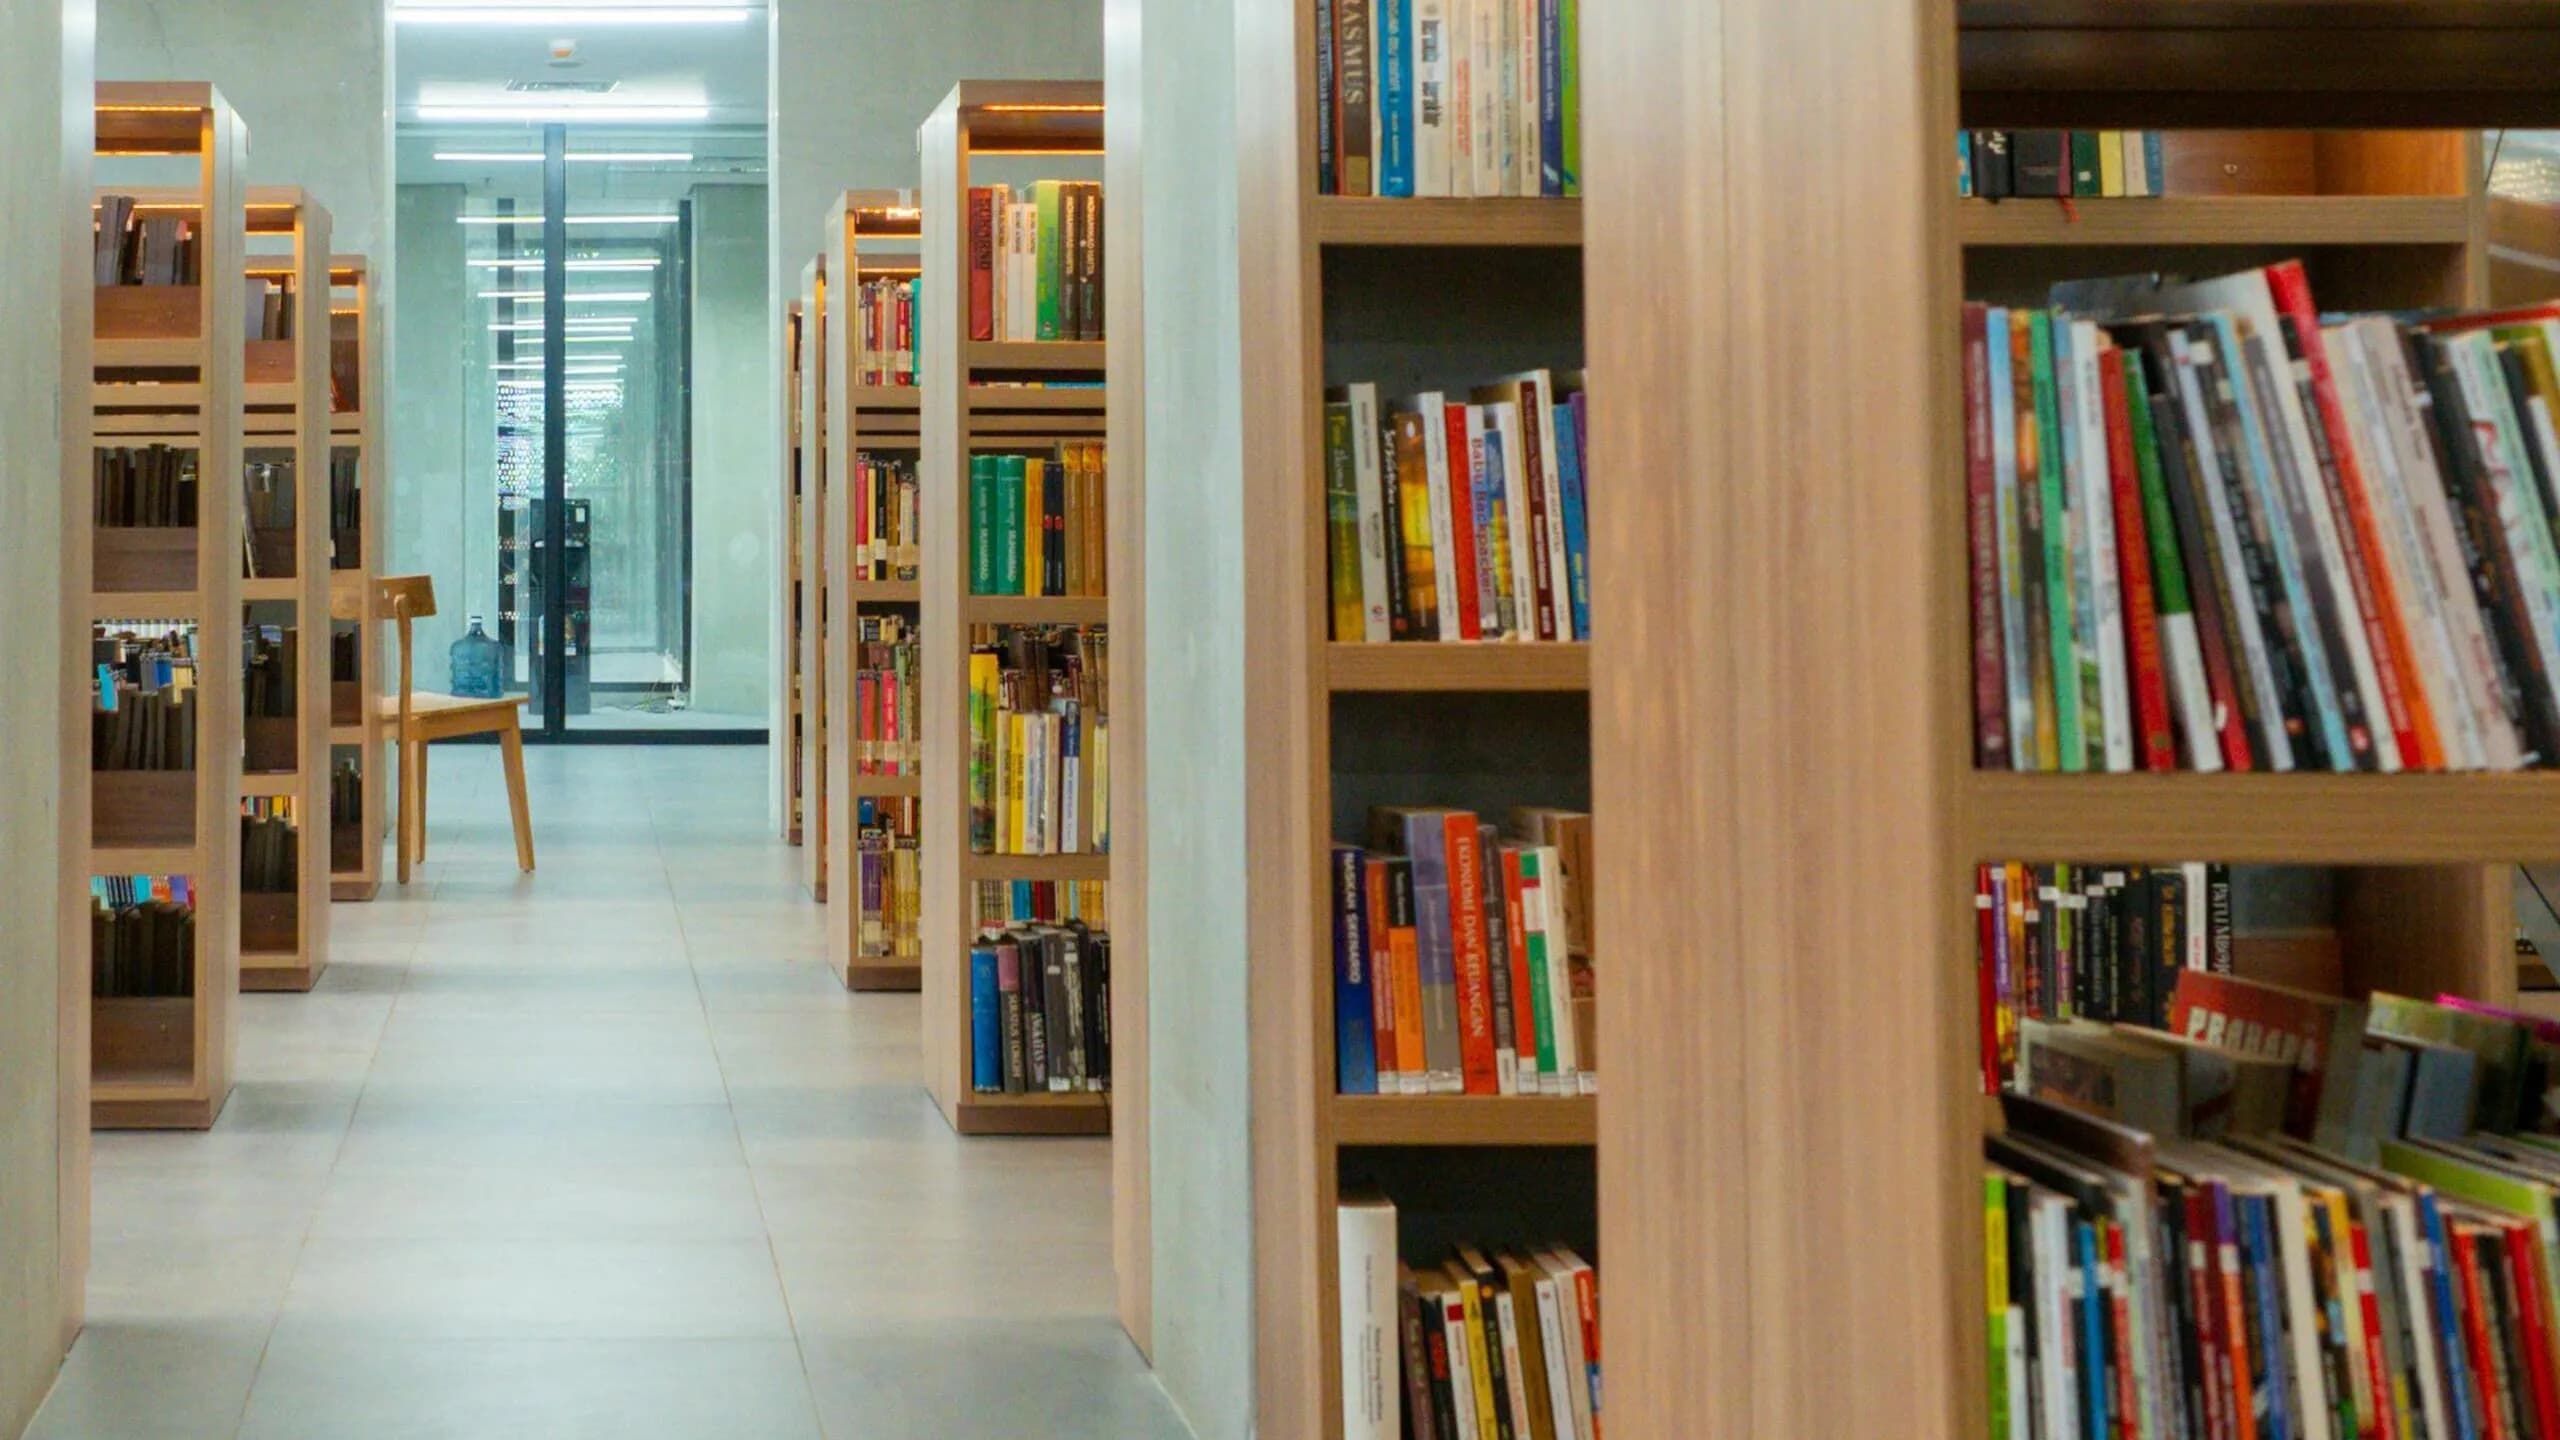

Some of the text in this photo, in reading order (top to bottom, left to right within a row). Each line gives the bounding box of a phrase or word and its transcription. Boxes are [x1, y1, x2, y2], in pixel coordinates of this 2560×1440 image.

[1471, 438, 1493, 595] Babu Backpacker
[1342, 853, 1362, 983] NASKAH SKENARIO
[1456, 836, 1486, 1038] EKONOMI DAN KEUANGAN
